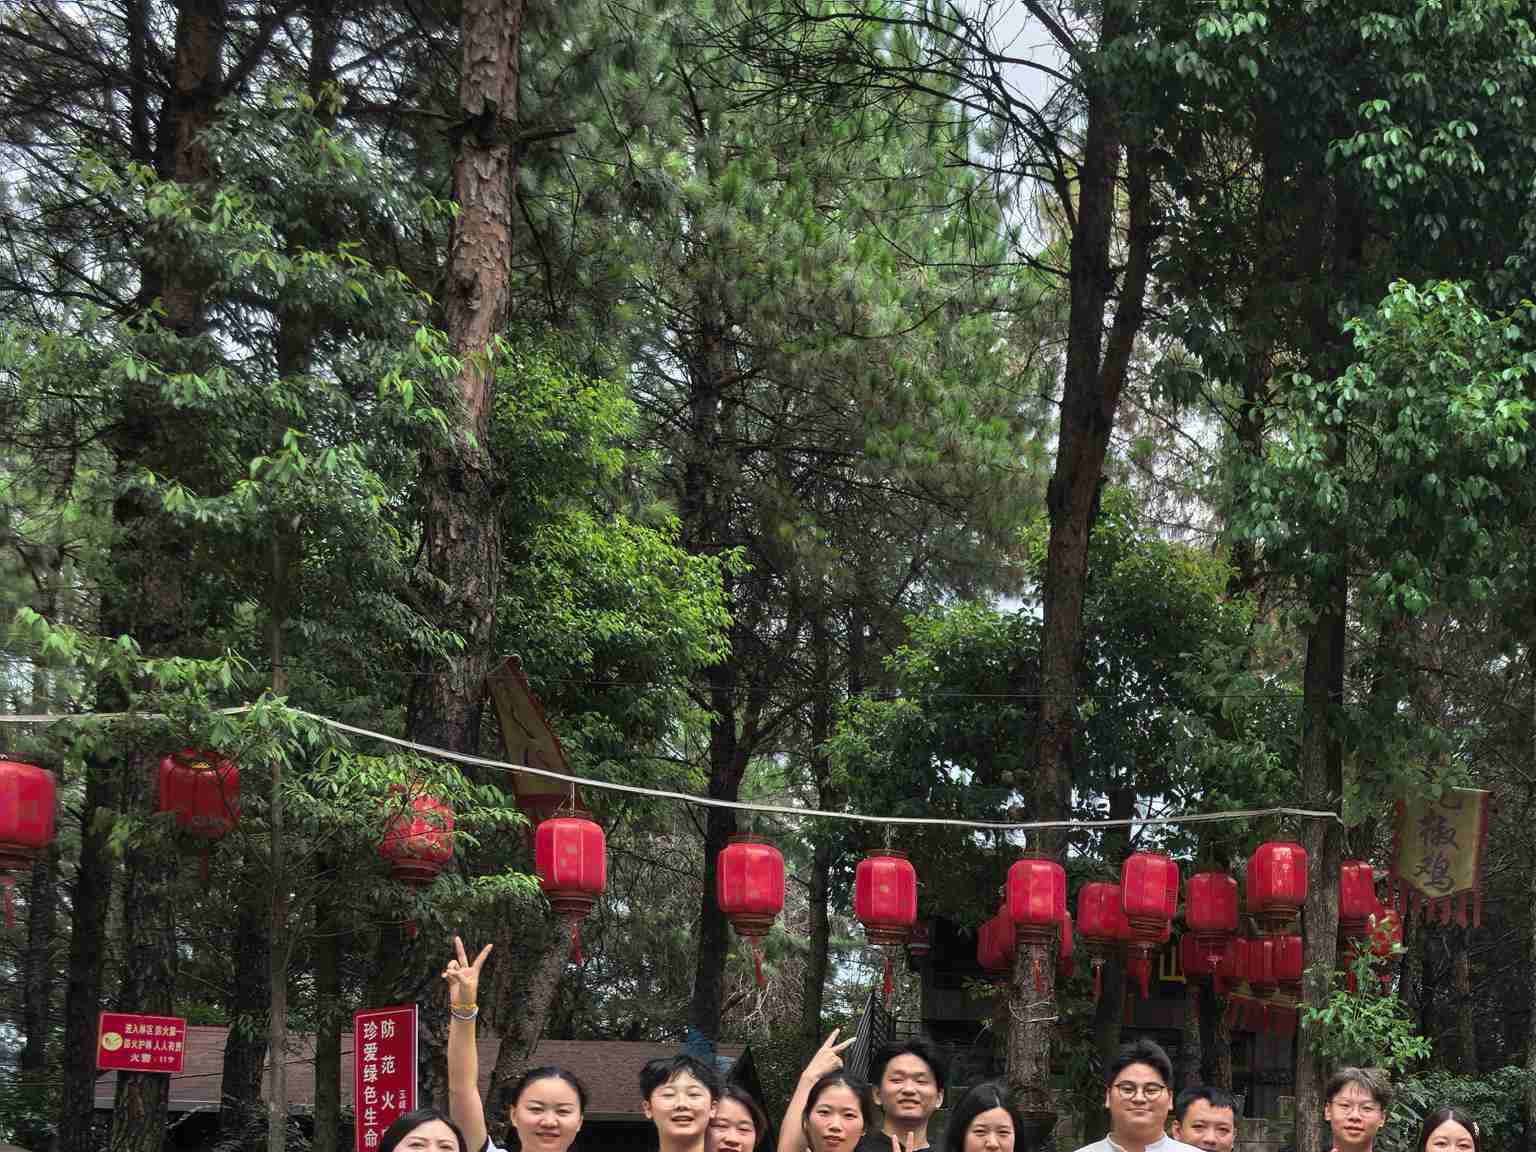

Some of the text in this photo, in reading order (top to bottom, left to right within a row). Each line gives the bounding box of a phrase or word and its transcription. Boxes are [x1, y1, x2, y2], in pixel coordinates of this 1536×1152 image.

[363, 1021, 379, 1148] 珍爱绿色生命
[381, 1019, 396, 1137] 防范火
